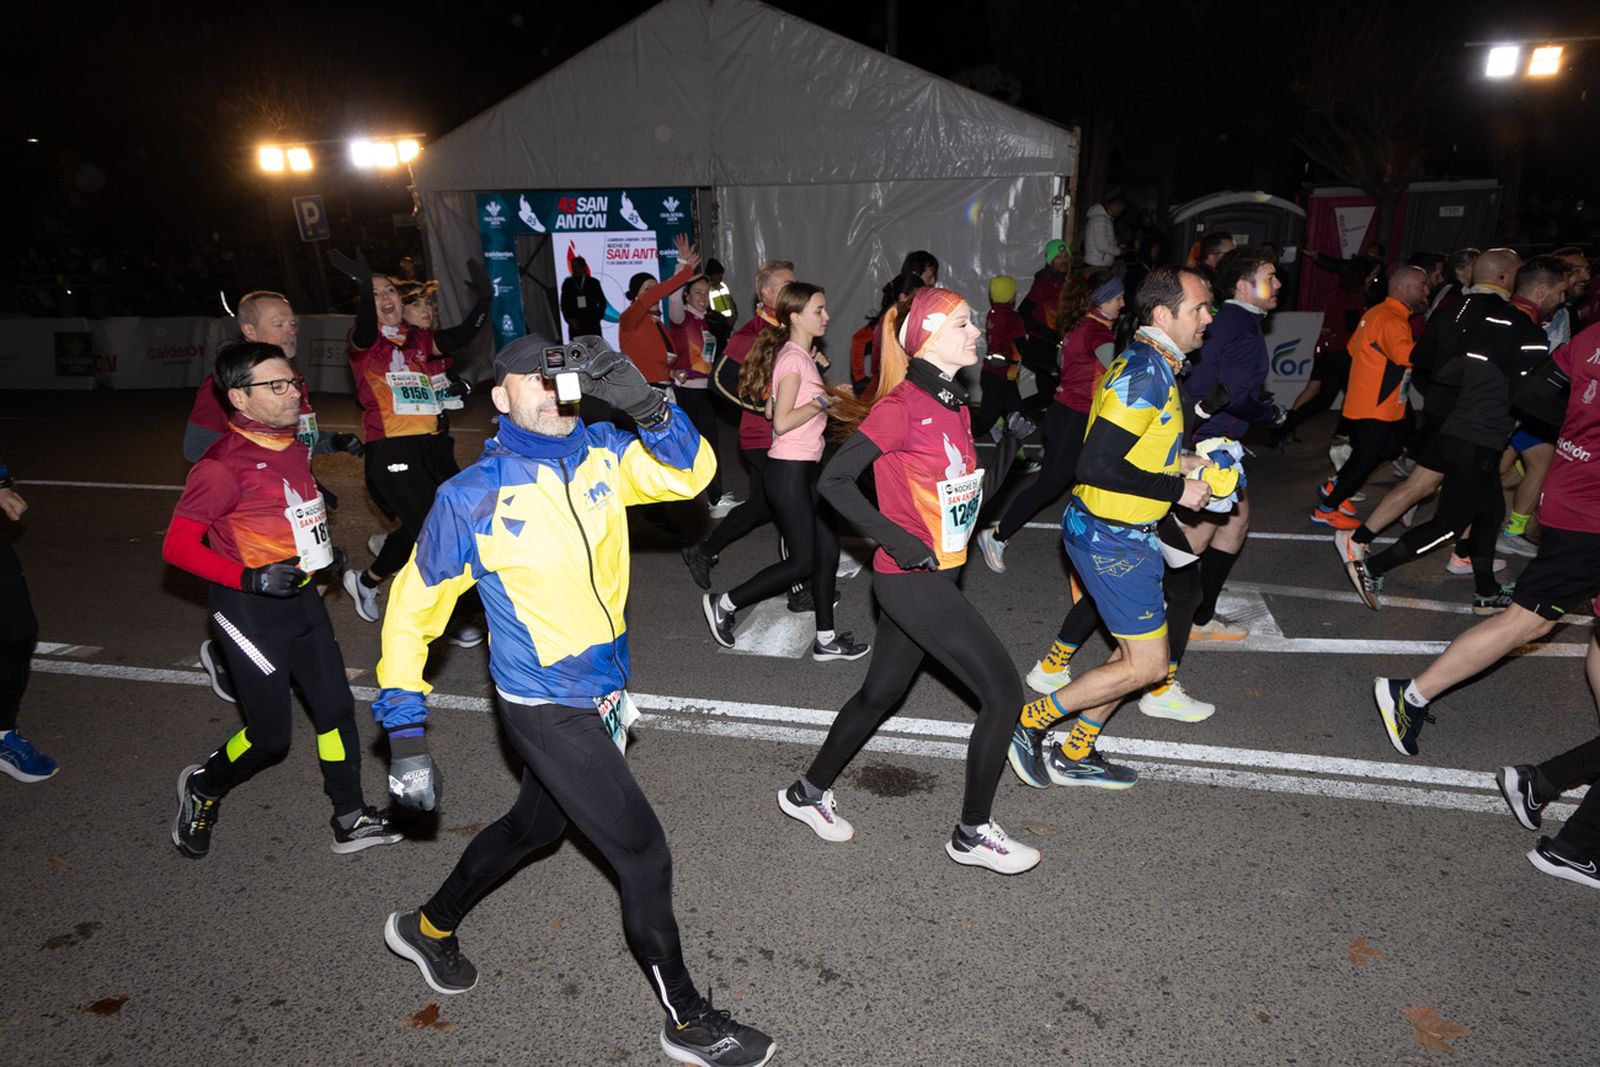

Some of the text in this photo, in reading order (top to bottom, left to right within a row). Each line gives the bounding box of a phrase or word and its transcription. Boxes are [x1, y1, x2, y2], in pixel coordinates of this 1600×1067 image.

[557, 196, 609, 214] 43 SAN
[301, 201, 320, 236] P
[555, 210, 608, 230] ANTÓN
[606, 248, 630, 260] SAN
[401, 386, 429, 401] 8156
[954, 484, 972, 494] NOCHE
[947, 495, 960, 506] SAN
[299, 518, 314, 529] SAN
